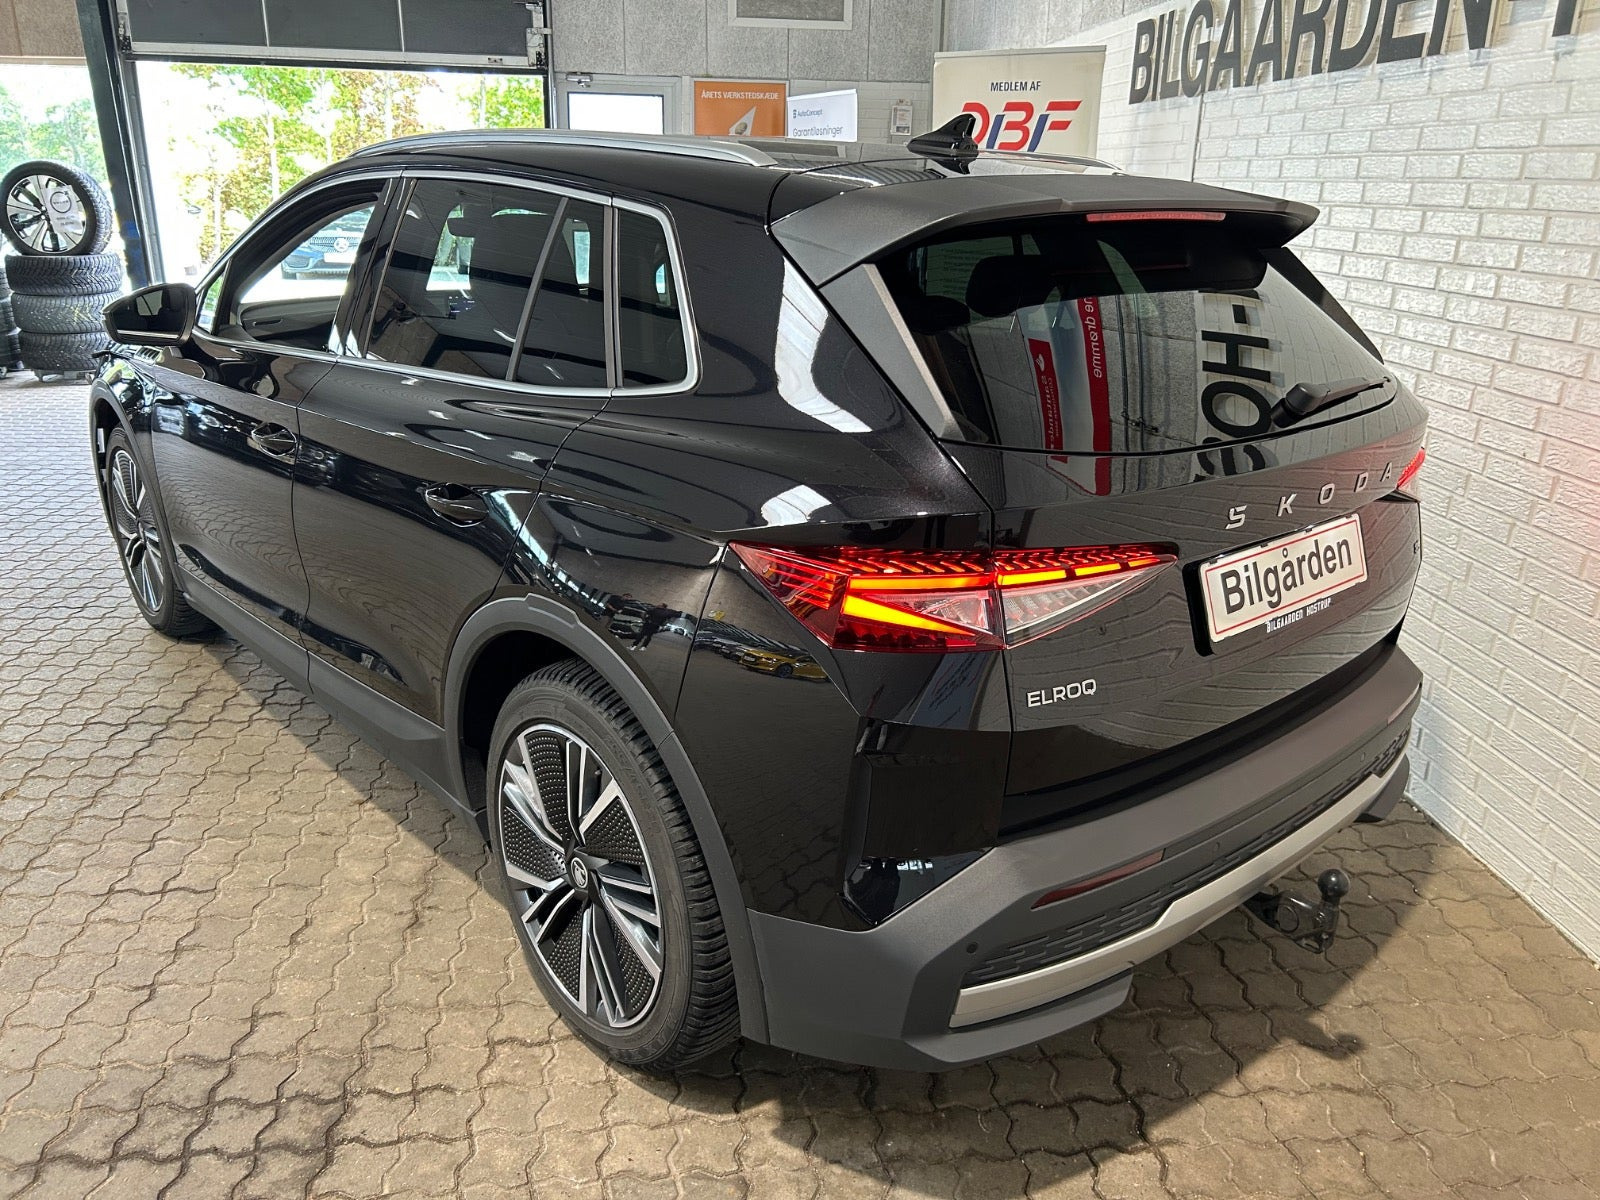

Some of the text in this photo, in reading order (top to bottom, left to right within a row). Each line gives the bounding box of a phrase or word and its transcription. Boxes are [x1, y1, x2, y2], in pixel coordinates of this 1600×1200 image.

[990, 80, 1042, 92] MEDLEM AF
[701, 90, 779, 100] ÅRETS VÆRKSTEDSKÆDE
[797, 108, 823, 117] AutoConcept
[792, 125, 844, 138] Garantiløsninger
[1220, 538, 1352, 615] Bilgården
[1026, 678, 1097, 708] ELROQ
